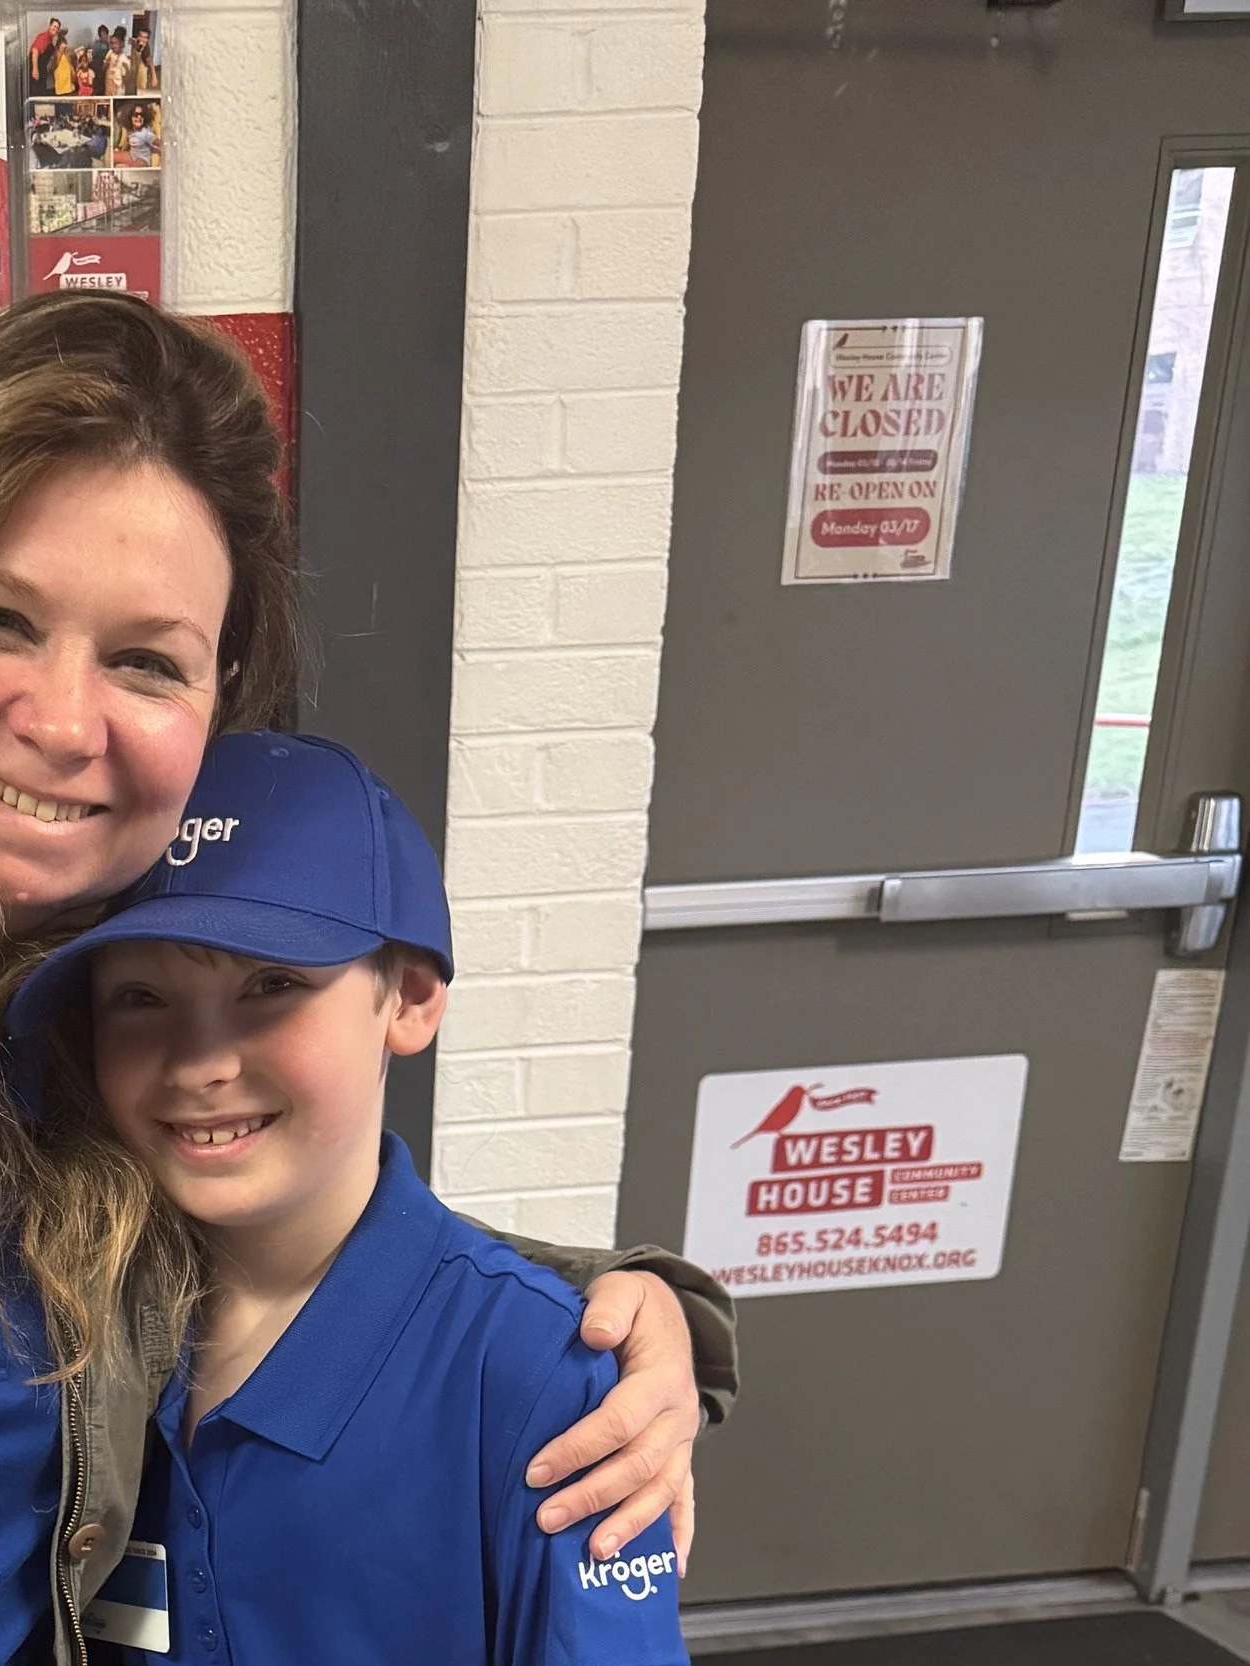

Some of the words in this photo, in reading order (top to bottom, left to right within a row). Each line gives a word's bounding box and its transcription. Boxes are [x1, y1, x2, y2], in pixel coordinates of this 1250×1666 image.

[65, 276, 123, 288] WESLEY
[827, 373, 874, 402] WE
[881, 373, 945, 402] ARE
[820, 408, 946, 438] CLOSED
[909, 480, 937, 499] ON
[821, 520, 878, 537] Monday
[880, 518, 919, 536] 03/17
[166, 818, 240, 866] ger
[784, 1131, 927, 1166] WESLEY
[893, 1166, 978, 1179] COMMUNITY
[756, 1177, 873, 1211] HOUSE
[891, 1187, 946, 1200] CENTER
[756, 1221, 938, 1257] 865.524.5494
[711, 1248, 976, 1286] WESLEYHOUSEKNOX.ORG
[579, 1551, 676, 1601] Kroger
